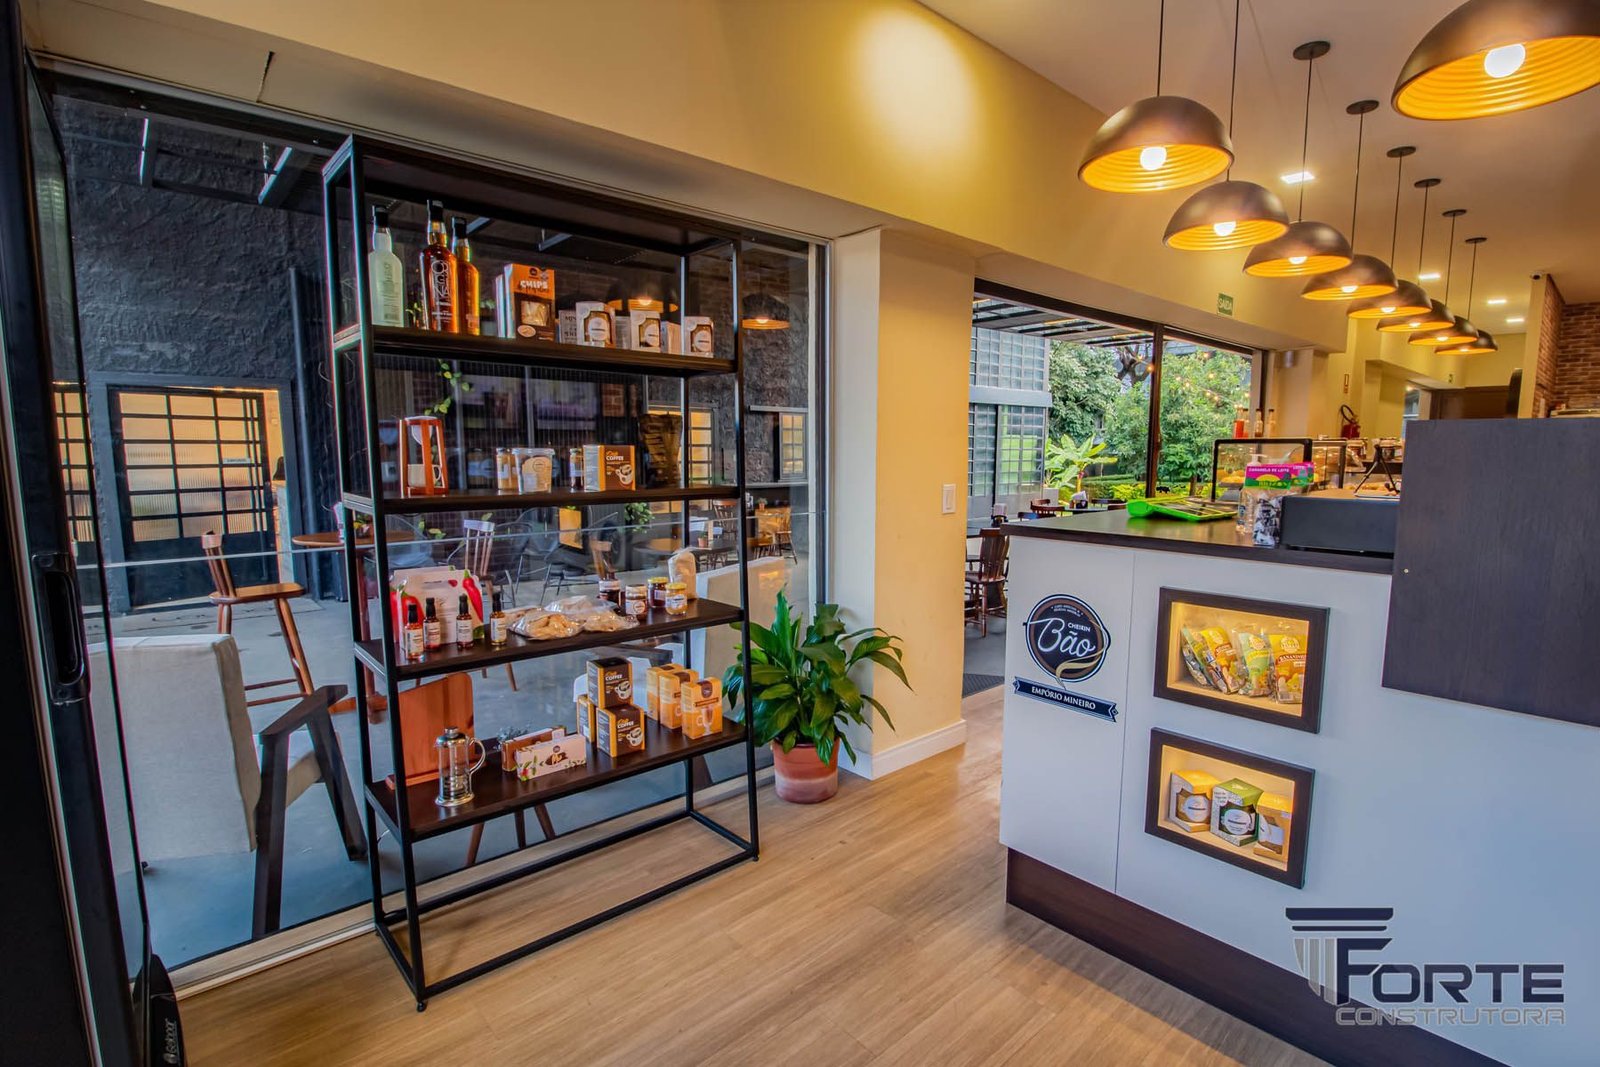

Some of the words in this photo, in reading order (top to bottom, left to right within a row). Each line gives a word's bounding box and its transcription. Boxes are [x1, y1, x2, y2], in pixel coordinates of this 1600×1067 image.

[520, 280, 548, 290] CHIPS
[1067, 622, 1091, 633] CHEIRIN
[1029, 617, 1097, 657] Bão
[1031, 685, 1063, 701] EMPÓRIO
[1063, 694, 1096, 710] MINEIRO
[617, 721, 634, 729] COFFEE
